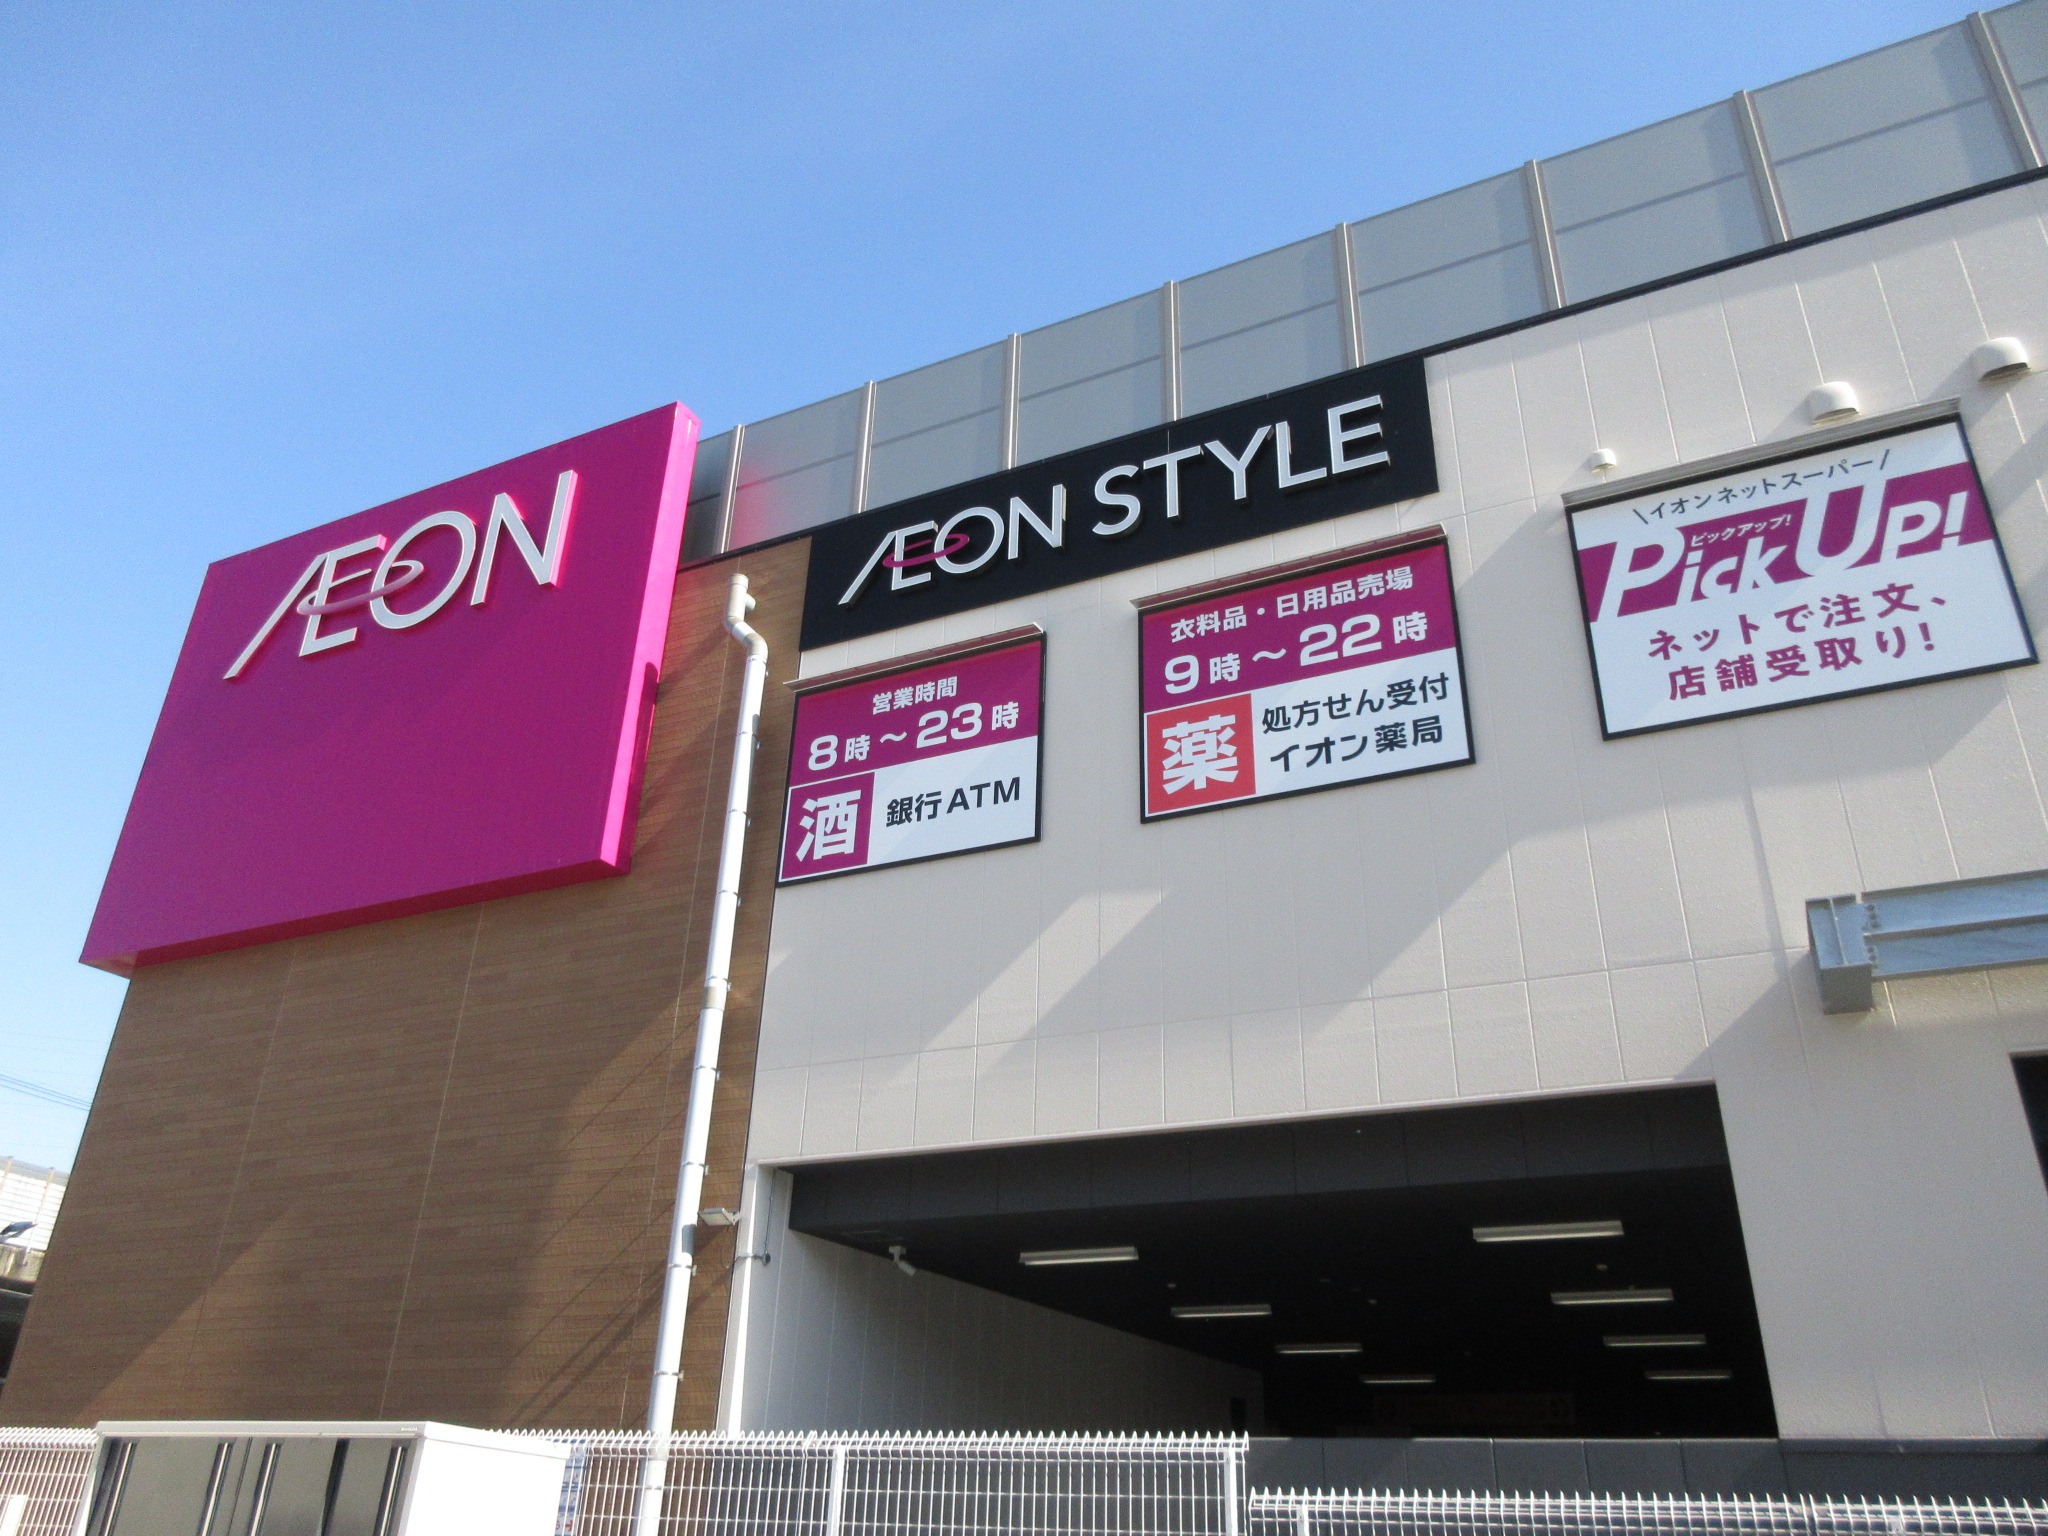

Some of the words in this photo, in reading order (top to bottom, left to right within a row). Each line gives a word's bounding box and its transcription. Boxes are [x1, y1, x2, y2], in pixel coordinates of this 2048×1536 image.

[1092, 394, 1391, 535] STYLE
[1650, 458, 1873, 519] イオンネットスーパー
[872, 676, 959, 716] 営業時間
[1261, 672, 1450, 735] 処方せん受付
[1162, 714, 1240, 796] 薬
[1270, 715, 1444, 773] イオン薬局
[795, 789, 862, 863] 酒
